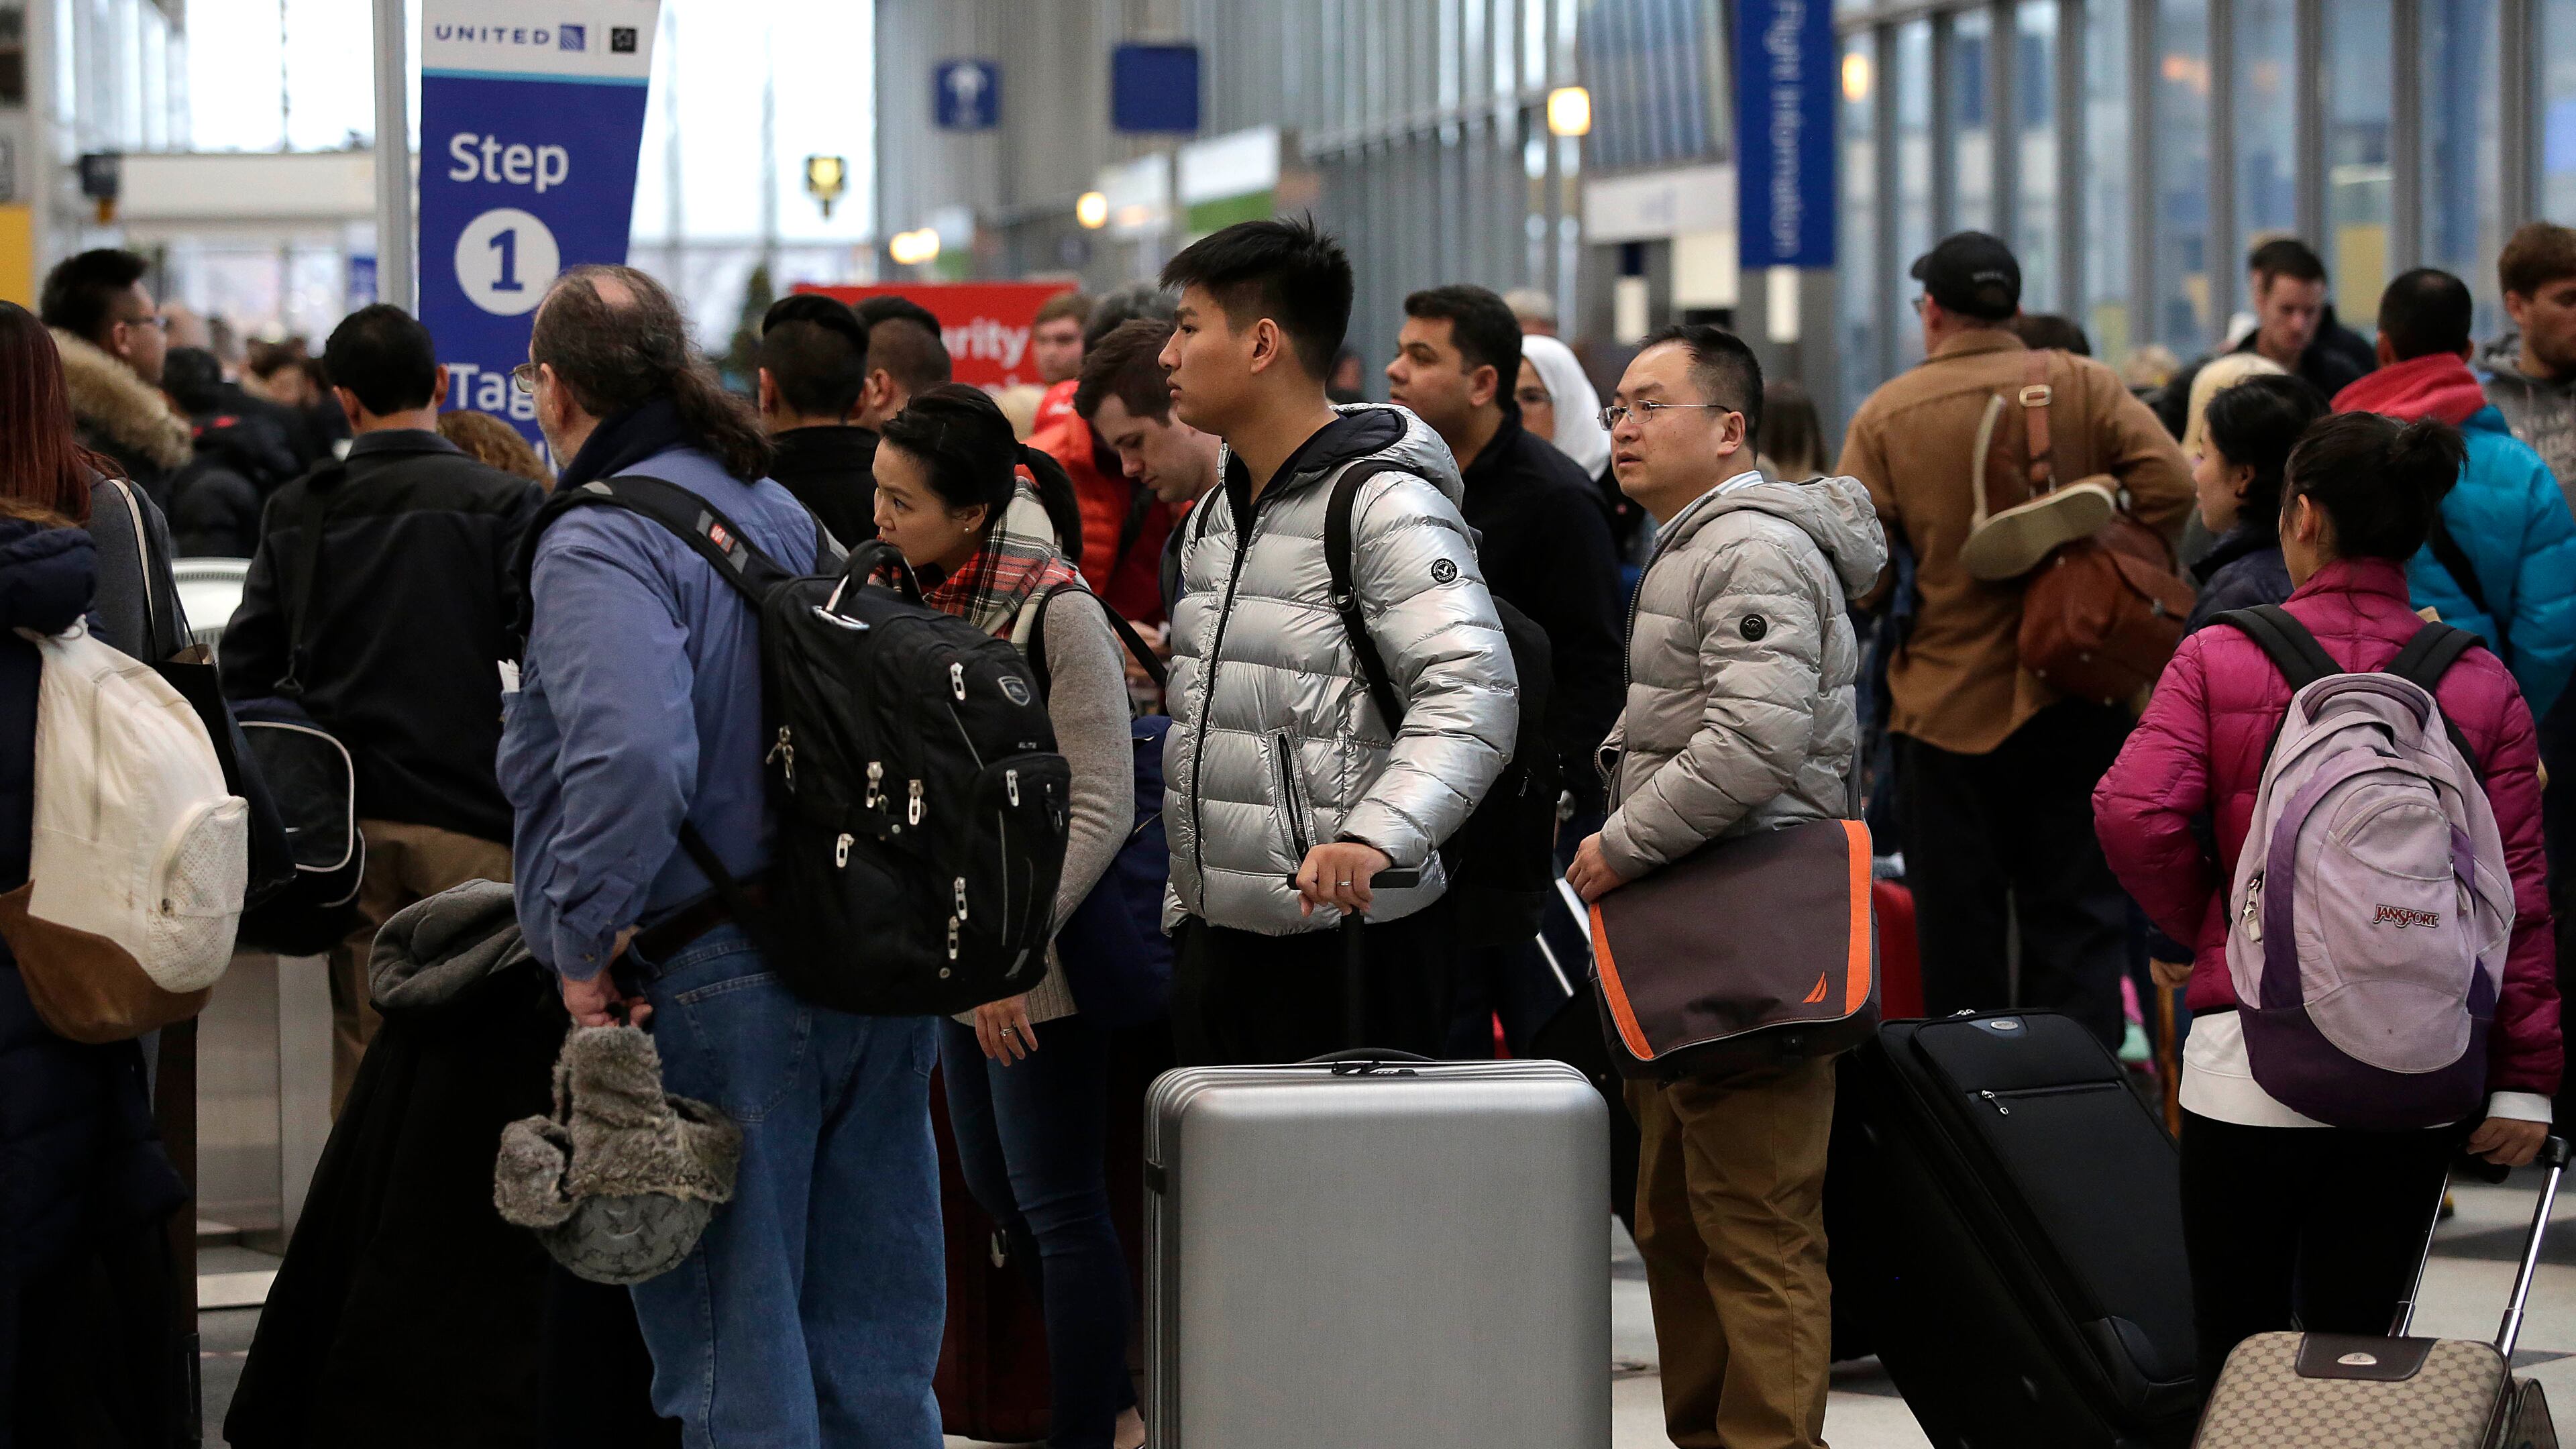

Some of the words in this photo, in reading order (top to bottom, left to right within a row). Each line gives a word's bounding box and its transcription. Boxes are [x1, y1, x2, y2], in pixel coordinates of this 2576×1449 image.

[435, 24, 550, 45] UNITED
[449, 132, 570, 194] Step
[489, 228, 524, 291] 1
